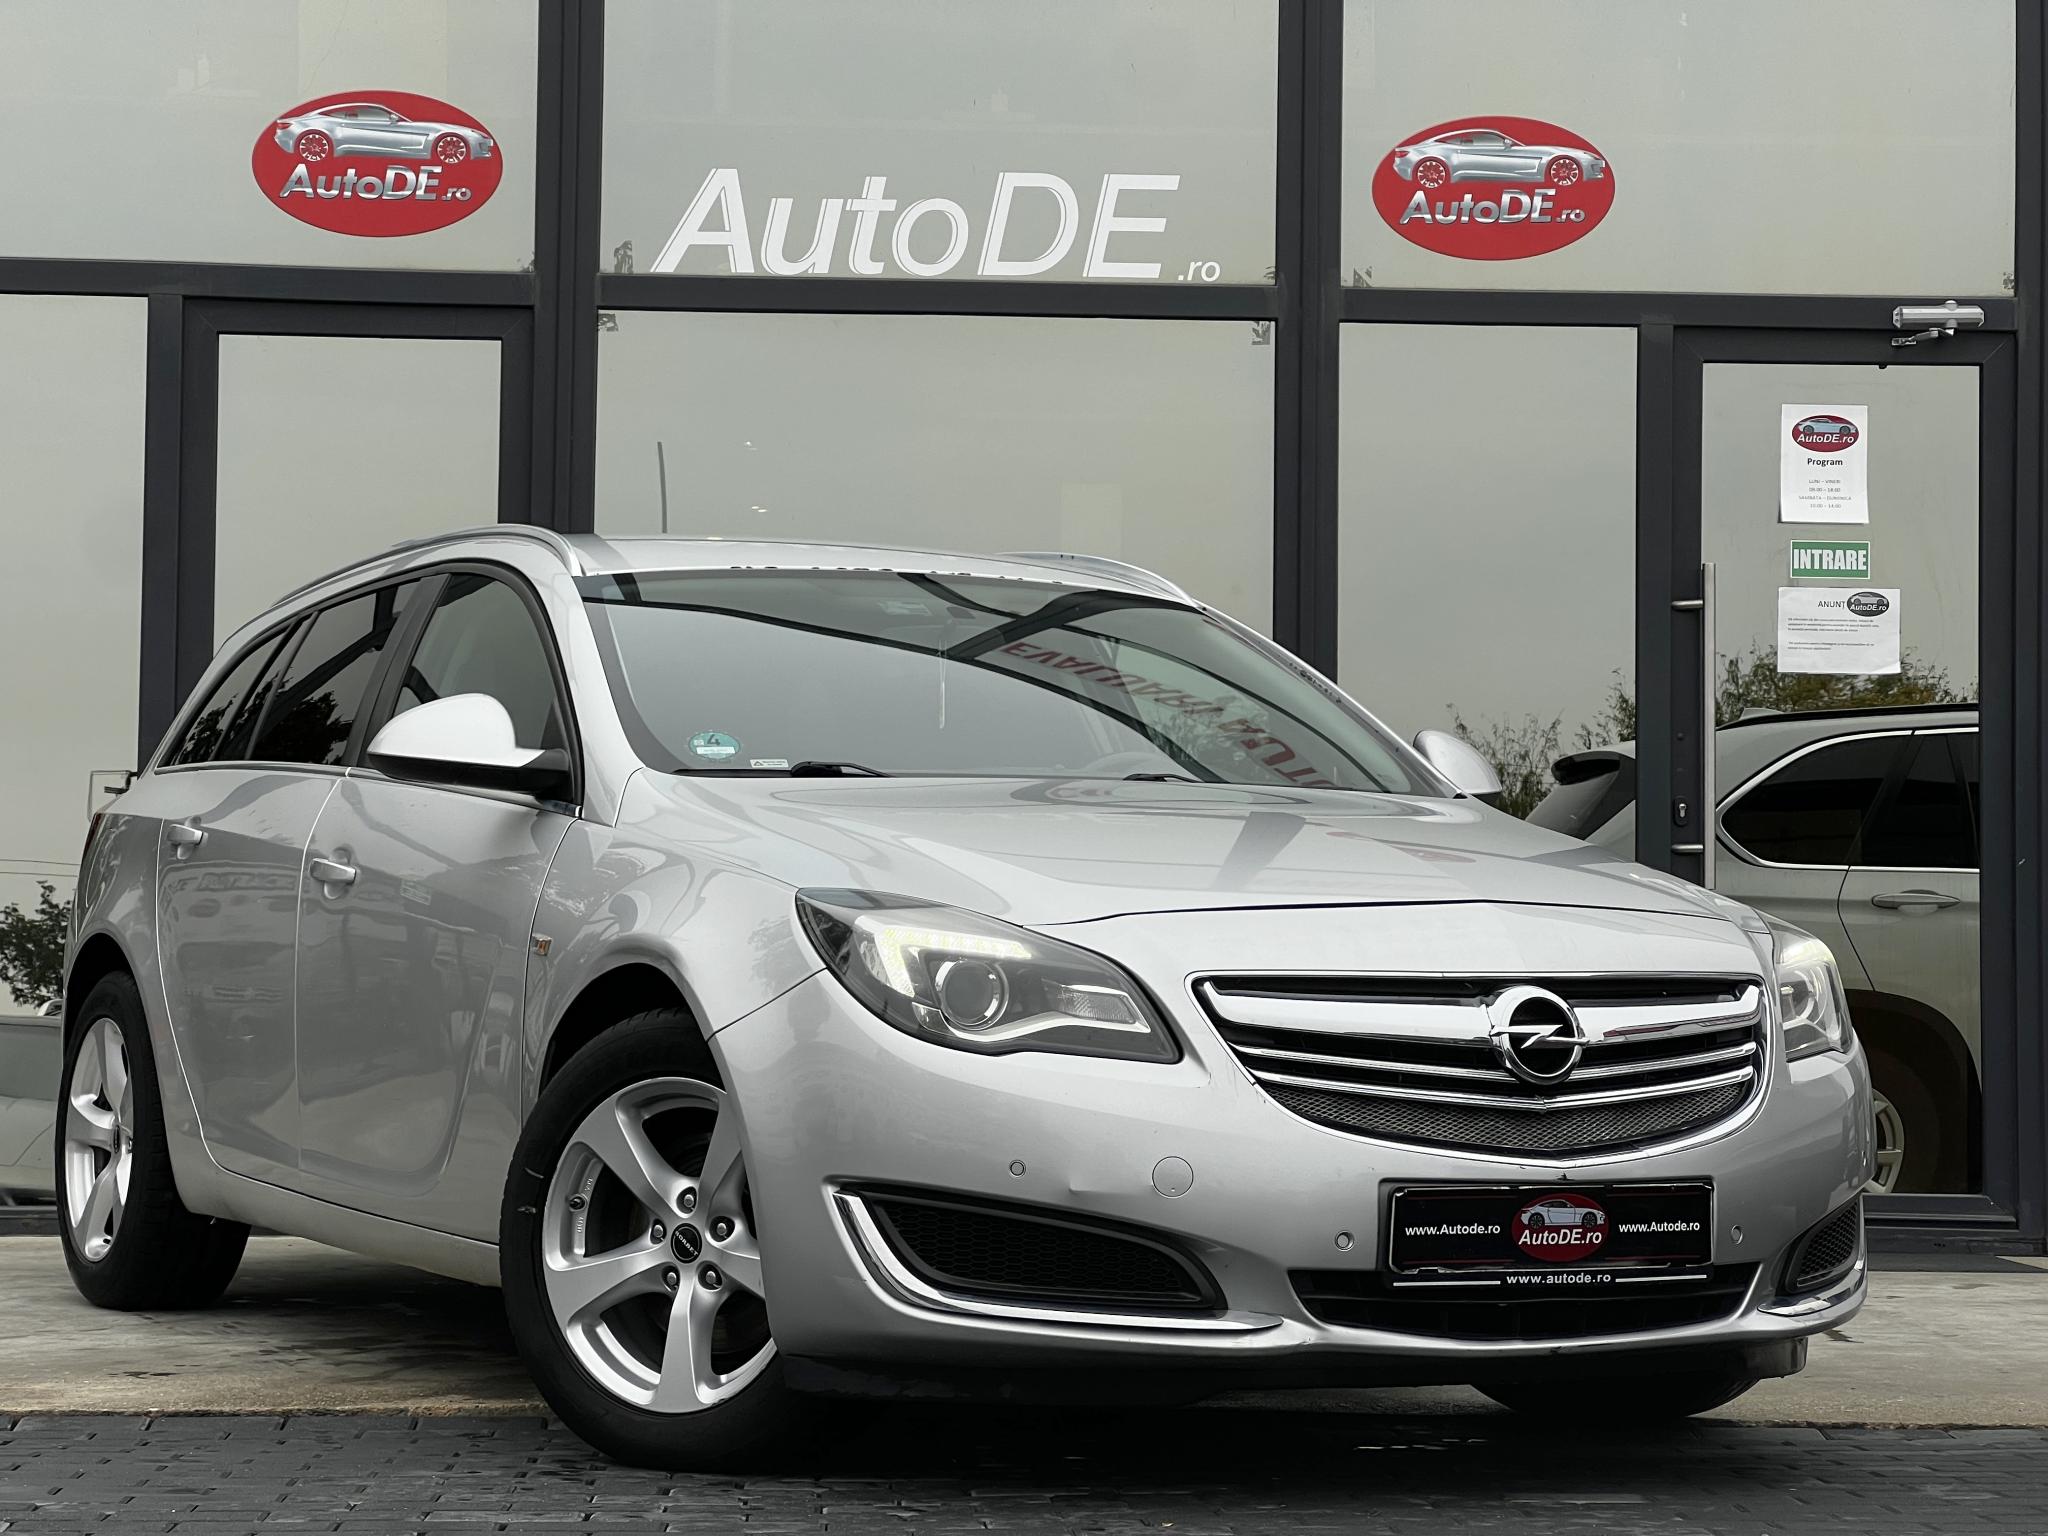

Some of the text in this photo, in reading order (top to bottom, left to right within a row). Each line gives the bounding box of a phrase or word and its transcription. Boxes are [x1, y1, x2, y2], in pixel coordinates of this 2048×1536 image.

[1797, 433, 1855, 443] AutoDE.ro
[1807, 457, 1843, 467] Program
[1793, 549, 1867, 571] INTRARE
[707, 734, 721, 746] 4
[1405, 1219, 1701, 1246] www.Autode.ro AutoDE.ro www.Autode.ro
[1506, 1272, 1612, 1285] www.autode.ro
